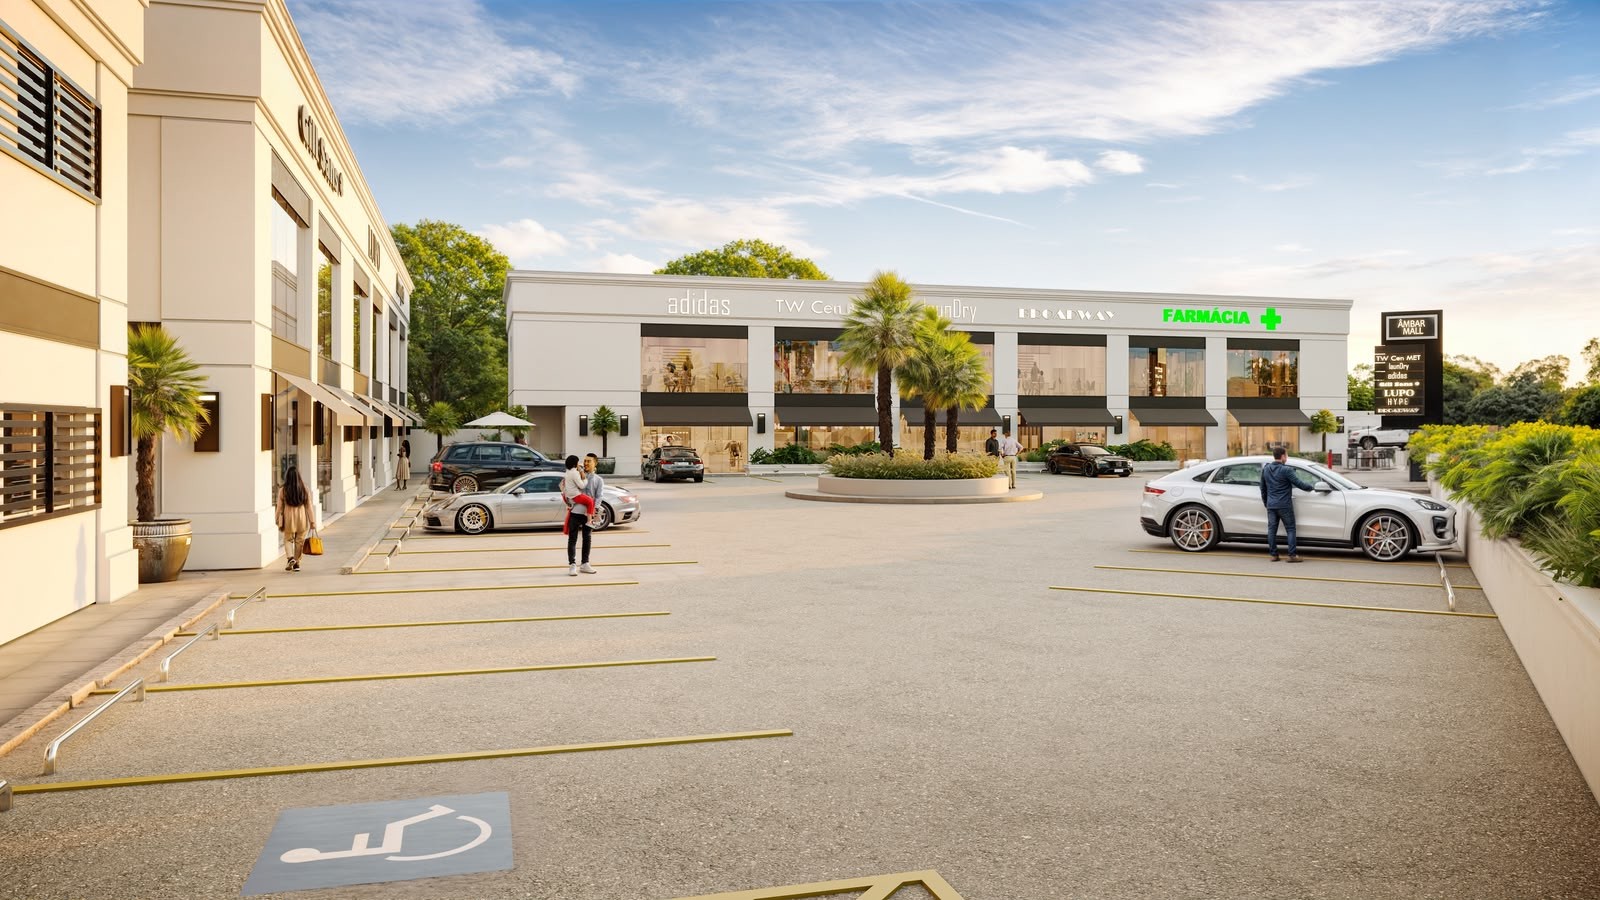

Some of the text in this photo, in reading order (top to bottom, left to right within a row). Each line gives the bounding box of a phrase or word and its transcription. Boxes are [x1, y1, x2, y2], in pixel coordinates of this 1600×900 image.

[668, 289, 730, 315] adidas
[775, 299, 805, 313] TW
[1163, 307, 1251, 324] FARMÁCIA
[1402, 327, 1424, 335] MALL
[1387, 371, 1408, 379] adidas
[1384, 389, 1415, 397] LUPO
[1387, 397, 1409, 406] HYPE
